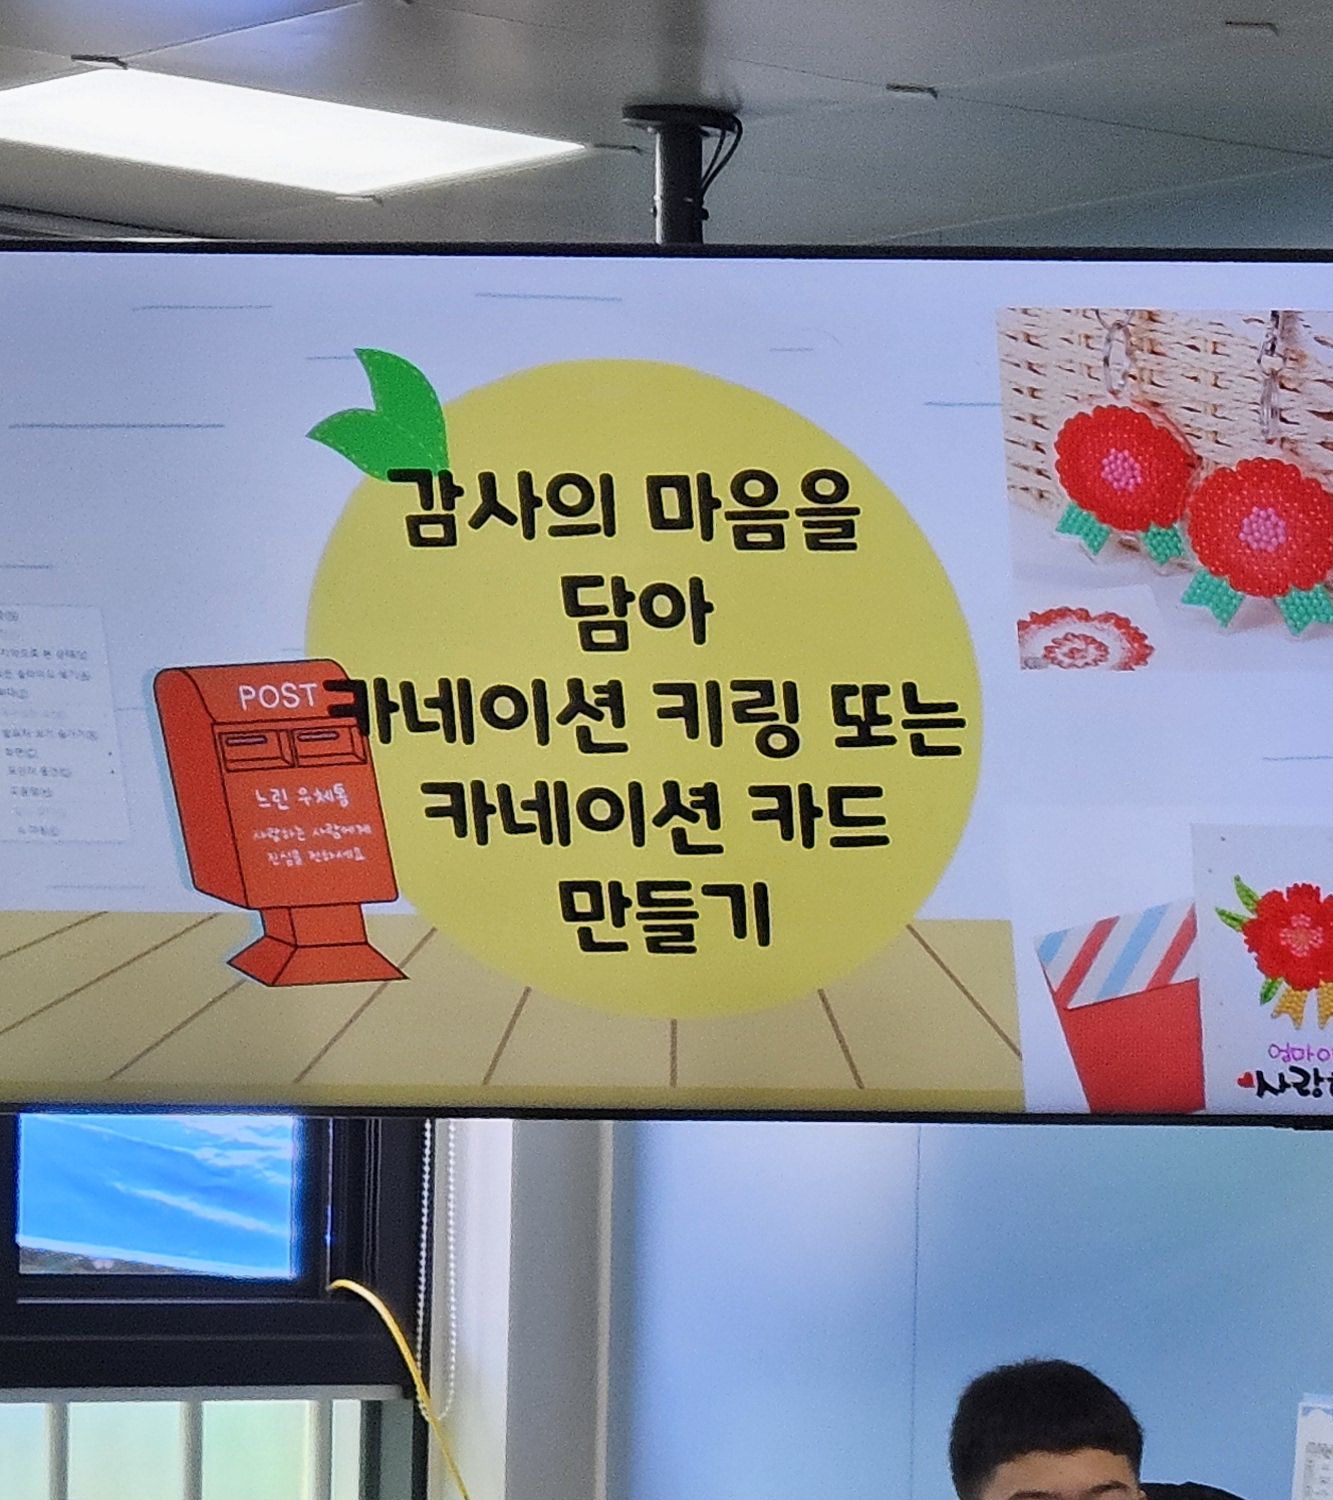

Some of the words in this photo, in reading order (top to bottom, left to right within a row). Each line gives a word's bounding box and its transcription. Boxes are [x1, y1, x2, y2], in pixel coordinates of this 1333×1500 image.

[388, 469, 616, 547] 감사의
[647, 469, 861, 550] 마음을
[560, 576, 714, 651] 담아
[239, 683, 317, 710] POST
[325, 677, 627, 753] 카네이션
[655, 679, 799, 758] 키링
[832, 681, 966, 757] 또는
[256, 789, 290, 810] 느린
[298, 783, 349, 807] 우체통
[422, 781, 720, 853] 카네이션
[749, 784, 890, 848] 카드
[560, 880, 772, 953] 만들기
